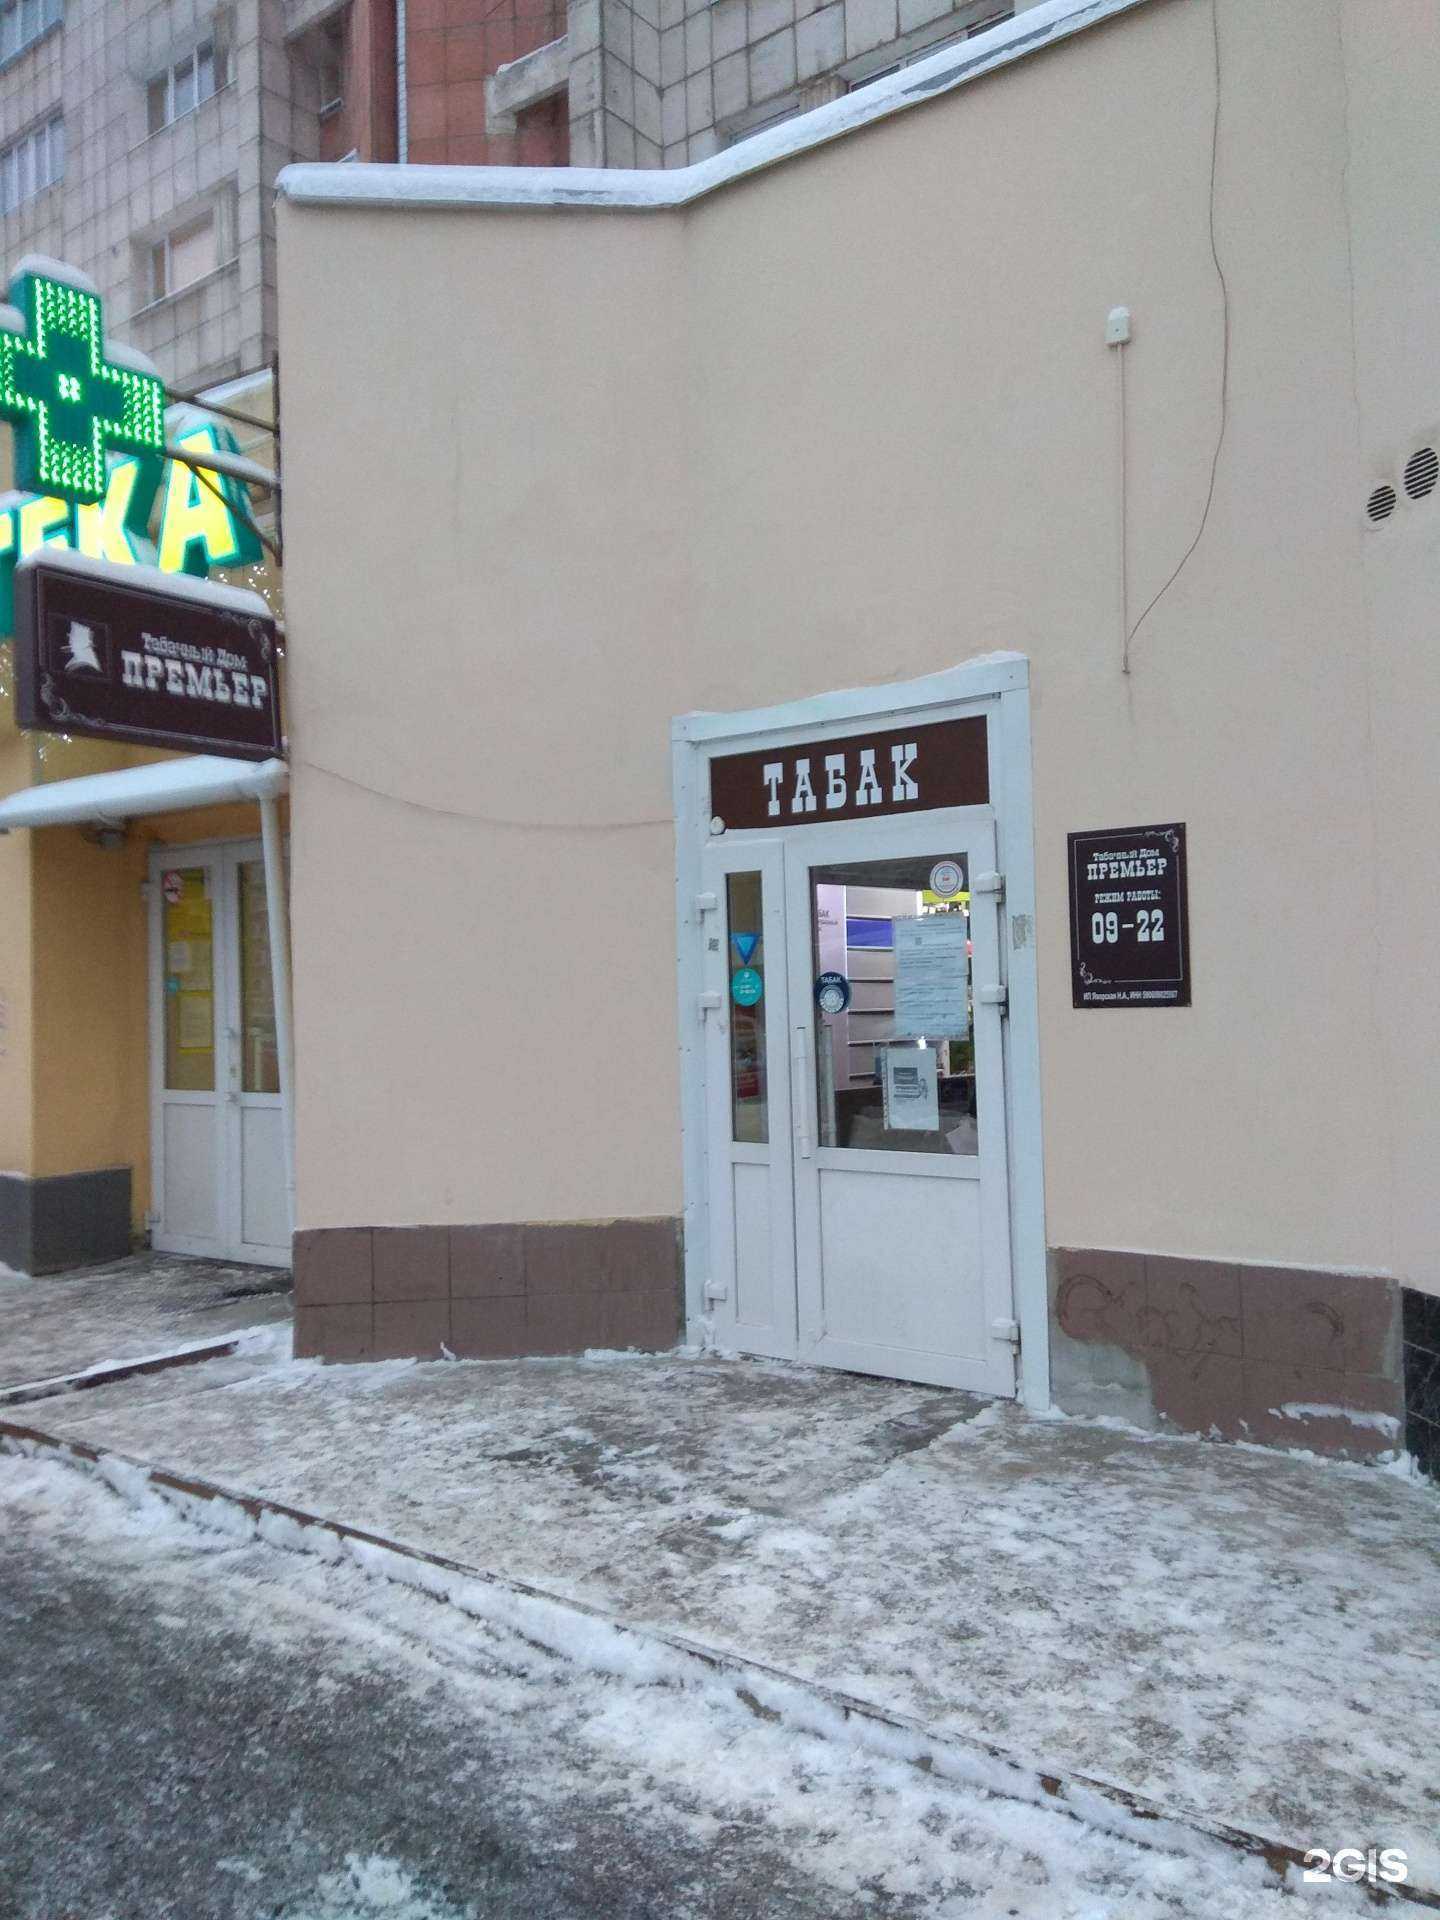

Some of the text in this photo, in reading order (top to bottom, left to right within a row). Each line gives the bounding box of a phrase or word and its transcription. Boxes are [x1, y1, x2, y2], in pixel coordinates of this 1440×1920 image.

[0, 424, 236, 574] ЕКА
[121, 650, 268, 710] ПРЕМЬЕР
[763, 742, 919, 816] ТАБАК
[1087, 857, 1168, 880] ПРЕМЬЕР
[1095, 892, 1125, 904] РЕЖИМ
